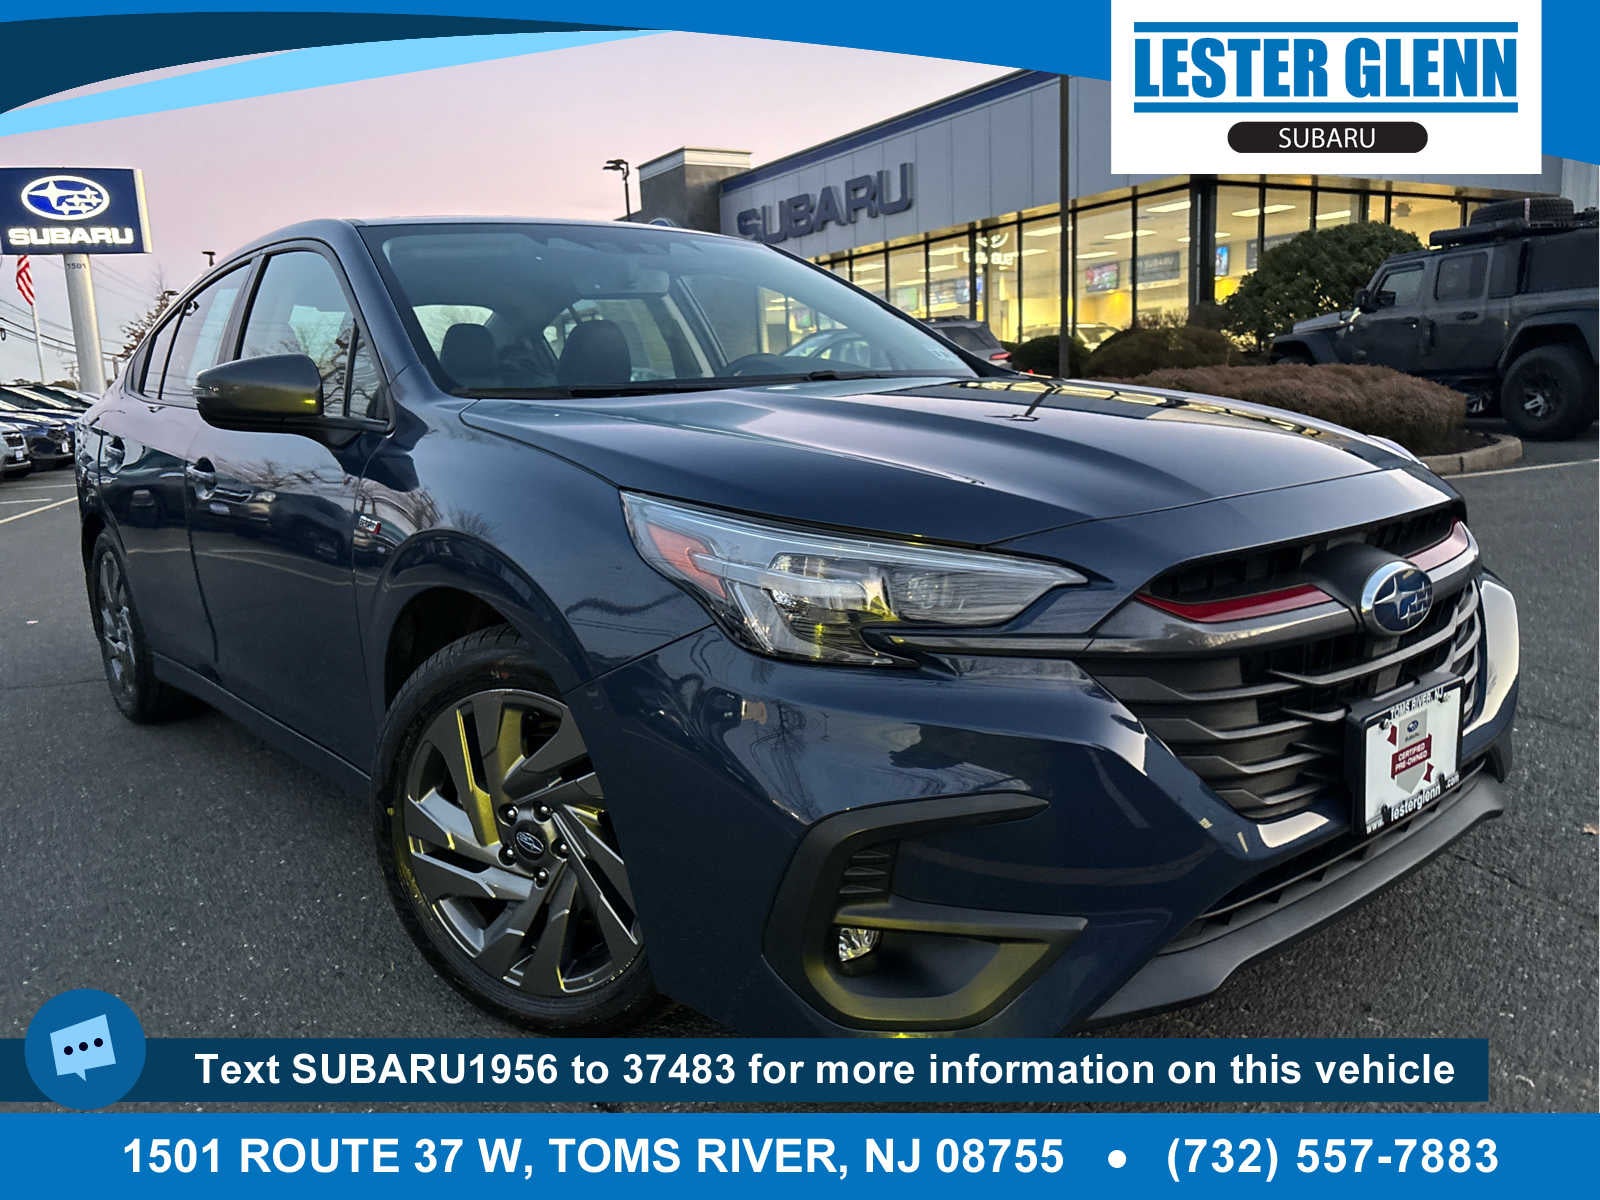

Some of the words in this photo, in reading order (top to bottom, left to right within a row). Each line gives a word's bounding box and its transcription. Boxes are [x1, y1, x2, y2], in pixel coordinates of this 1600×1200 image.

[737, 163, 913, 244] SUBARU
[8, 227, 134, 245] SUBARU
[1390, 703, 1411, 719] TOMS
[1434, 687, 1444, 700] NJ
[1394, 751, 1428, 773] PRE-OWNED
[1398, 742, 1426, 761] CERTIFIED
